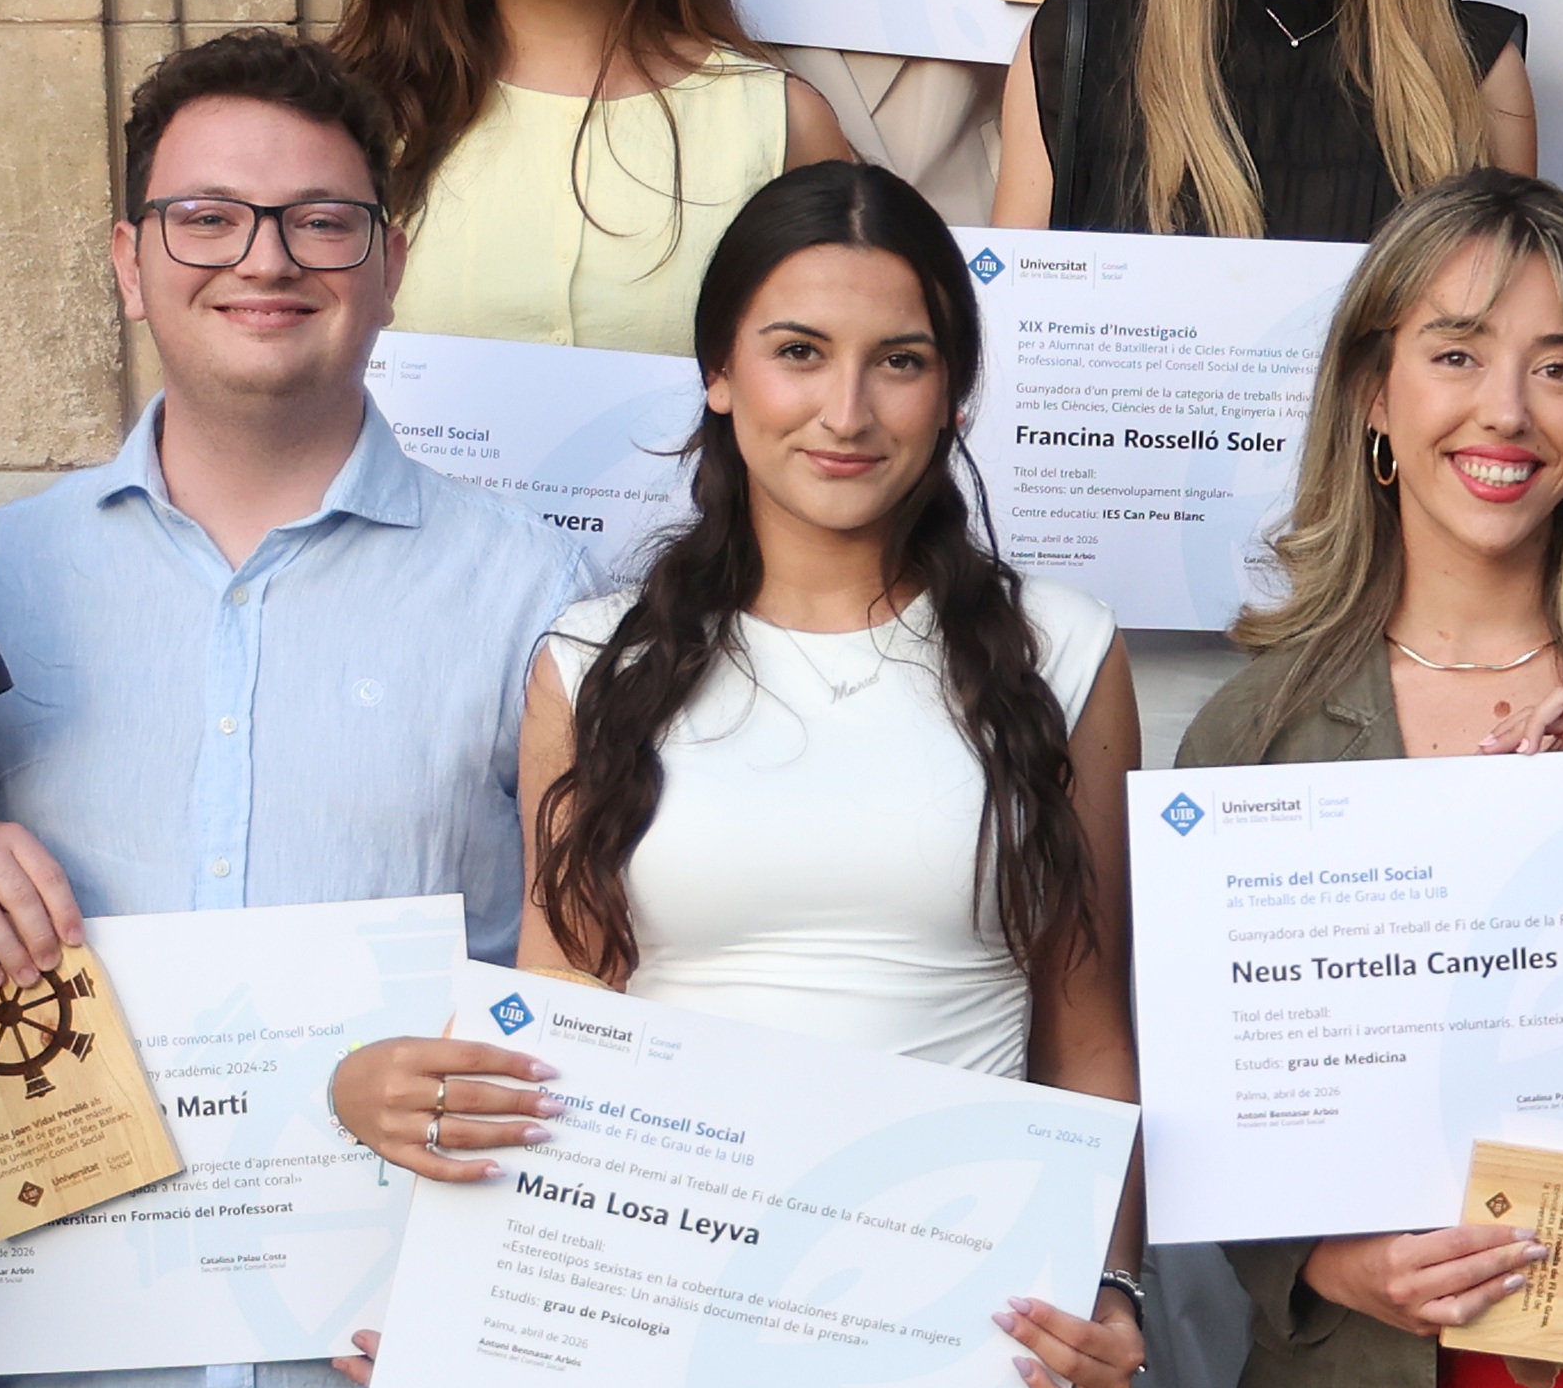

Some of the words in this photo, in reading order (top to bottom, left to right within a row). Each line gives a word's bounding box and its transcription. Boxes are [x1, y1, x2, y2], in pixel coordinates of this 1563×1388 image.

[976, 260, 997, 273] UIB
[1020, 258, 1087, 272] Universitat
[1018, 320, 1043, 333] XIX
[1048, 321, 1096, 335] Premis
[1099, 323, 1198, 342] d'Investigació
[392, 422, 444, 438] Consell
[447, 426, 490, 442] Social
[1016, 425, 1115, 448] Francina
[1124, 428, 1219, 451] Rosselló
[1226, 431, 1286, 453] Soler
[1011, 506, 1047, 518] Centre
[1050, 508, 1099, 519] educatiu:
[1102, 509, 1121, 520] IES
[1123, 509, 1145, 520] Can
[1148, 510, 1170, 521] Peu
[1173, 510, 1205, 522] Blanc
[1170, 808, 1195, 823] UIB
[1221, 799, 1301, 814] Universitat
[1226, 872, 1283, 889] Premis
[1288, 870, 1314, 886] del
[1318, 868, 1379, 885] Consell
[1384, 865, 1433, 882] Social
[1232, 961, 1302, 984] Neus
[1311, 953, 1417, 980] Tortella
[1427, 946, 1558, 979] Canyelles
[498, 1004, 524, 1024] UIB
[552, 1013, 633, 1043] Universitat
[164, 1064, 222, 1078] acadèmic
[226, 1059, 278, 1075] 2024-25
[1234, 1057, 1285, 1072] Estudis:
[1288, 1058, 1319, 1073] grau
[1323, 1054, 1340, 1068] de
[1344, 1051, 1407, 1065] Medicina
[177, 1090, 248, 1118] Martí
[598, 1101, 626, 1119] del
[629, 1107, 692, 1133] Consell
[694, 1121, 746, 1145] Social
[110, 1211, 128, 1223] en
[130, 1208, 191, 1222] Formació
[194, 1206, 215, 1218] del
[218, 1202, 293, 1217] Professorat
[516, 1171, 596, 1210] María
[606, 1192, 669, 1226] Losa
[679, 1208, 760, 1246] Leyva
[490, 1285, 540, 1306] Estudis:
[542, 1299, 576, 1315] grau
[579, 1306, 597, 1320] de
[600, 1310, 670, 1337] Psicologia
